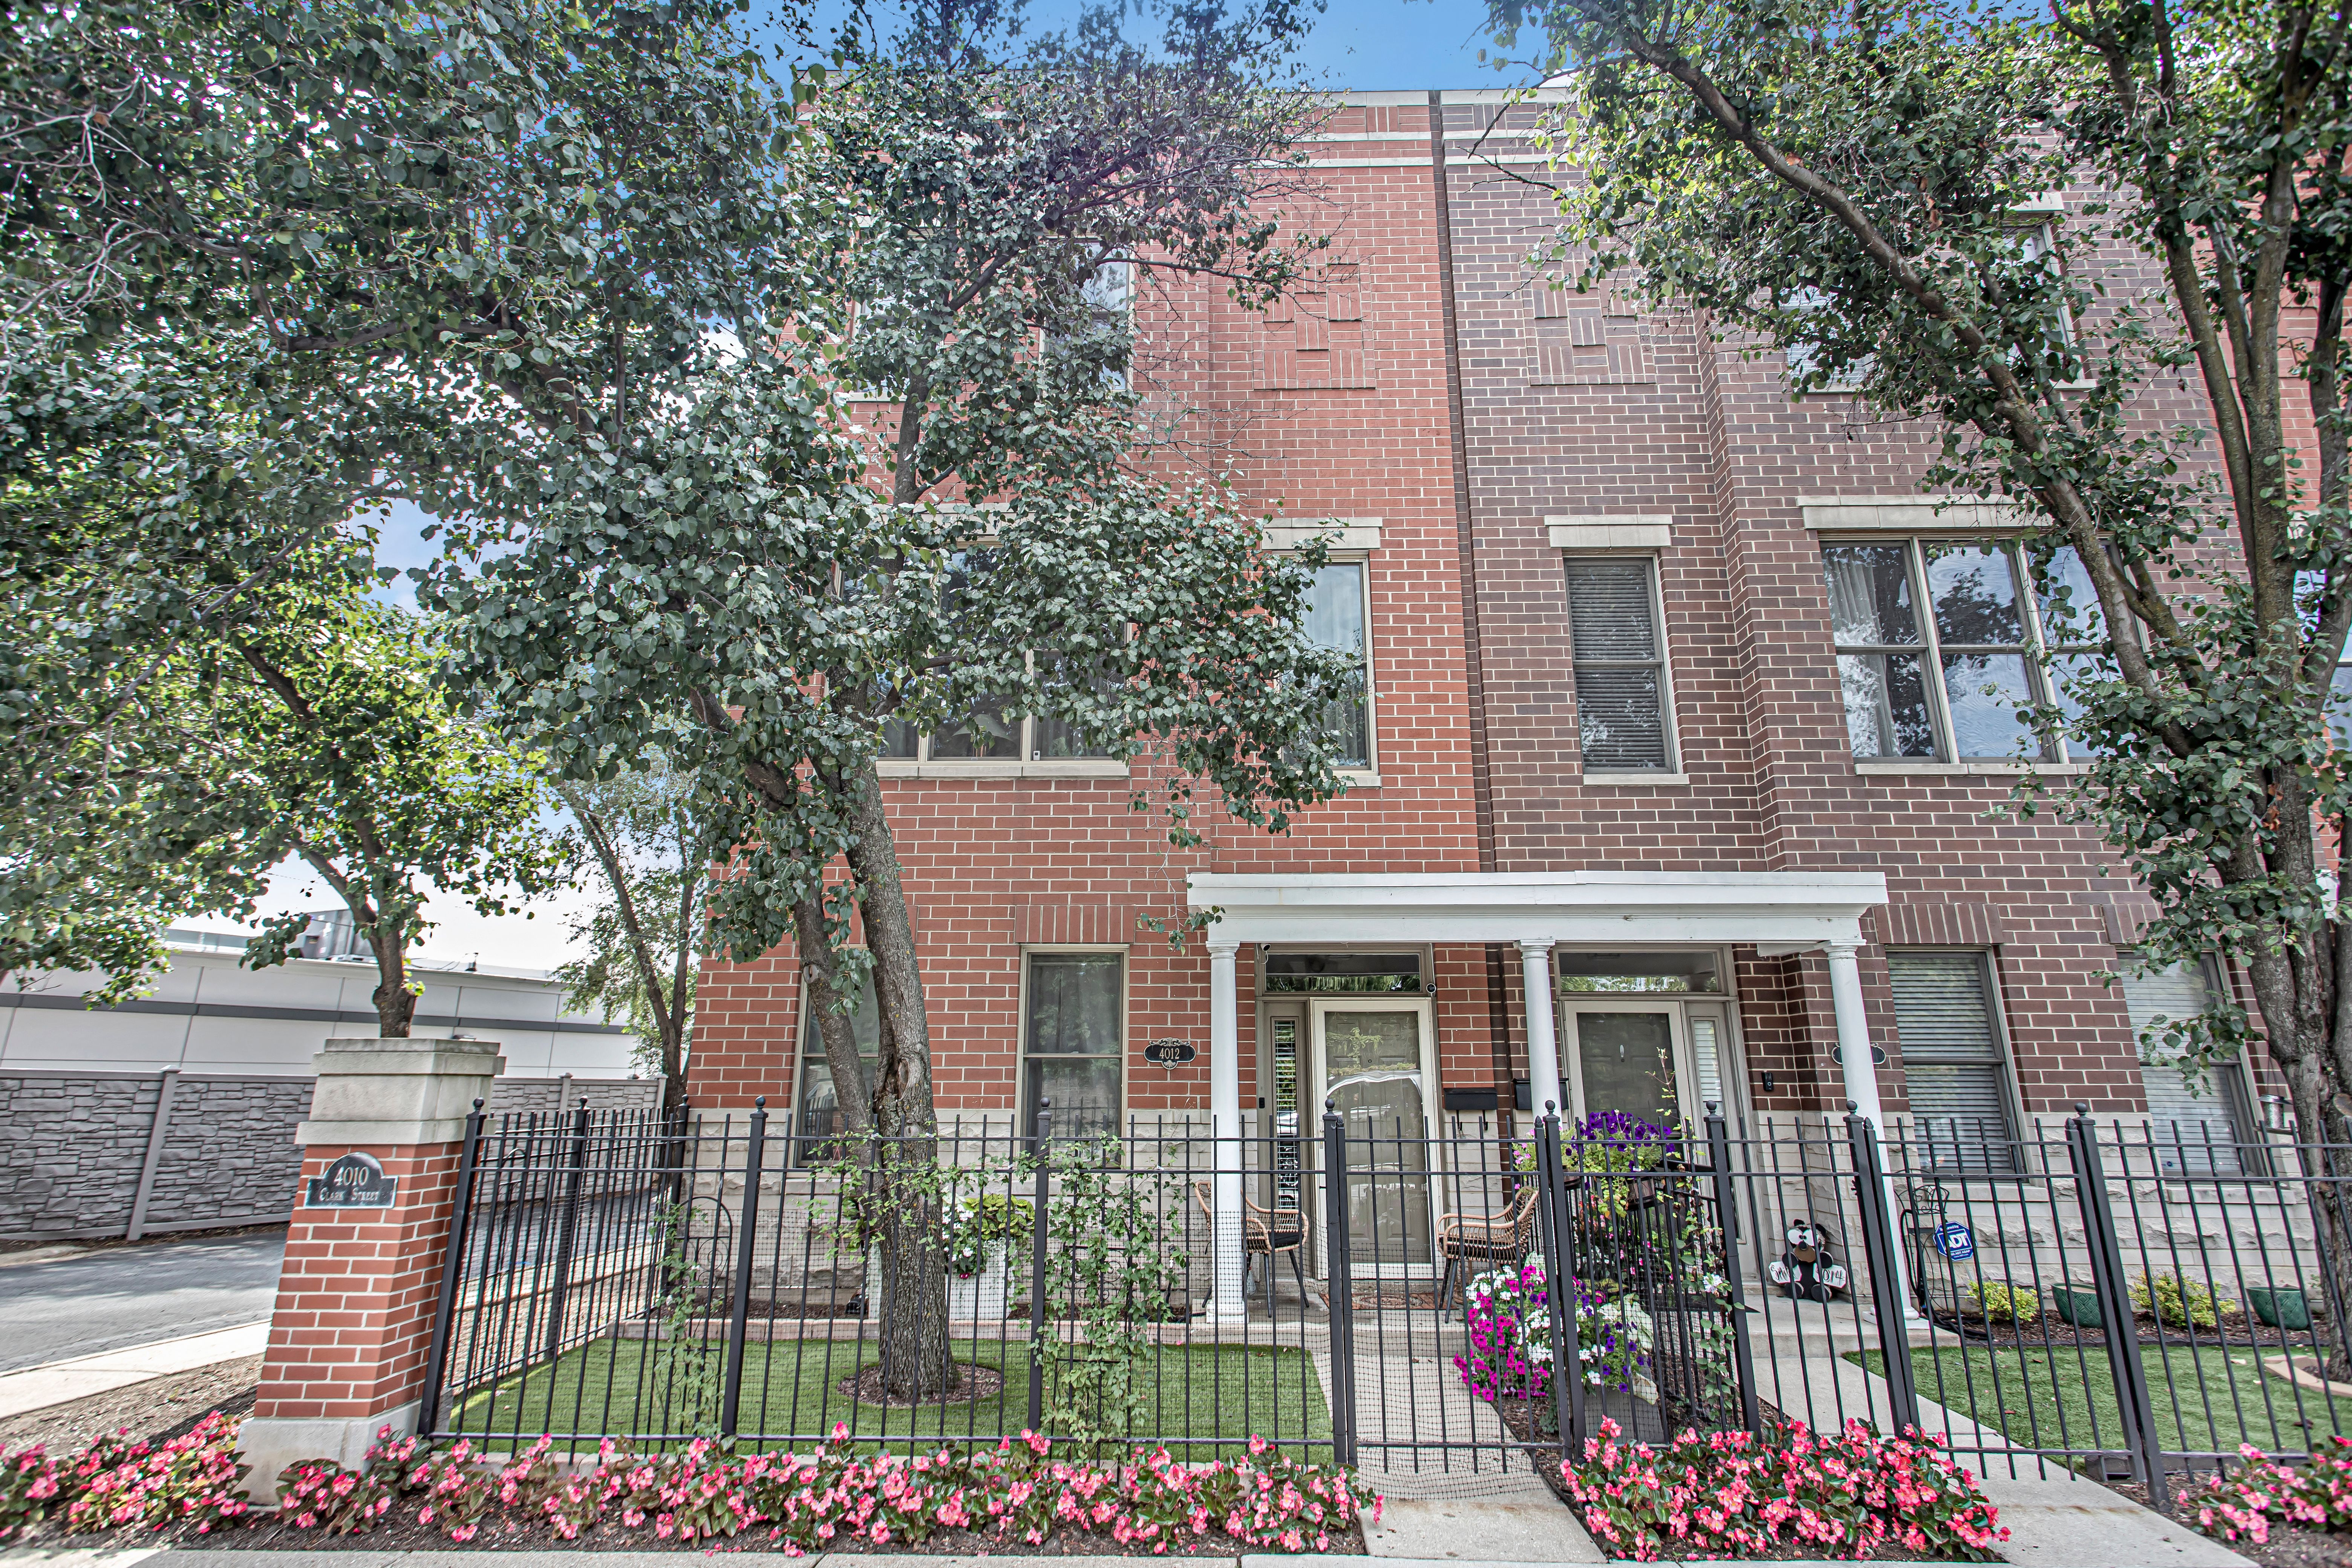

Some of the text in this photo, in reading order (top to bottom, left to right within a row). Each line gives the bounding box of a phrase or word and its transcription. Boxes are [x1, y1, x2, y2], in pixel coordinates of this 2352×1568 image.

[1159, 1048, 1179, 1059] 4012
[334, 1166, 369, 1186] 4010
[1815, 1268, 1845, 1286] 014
